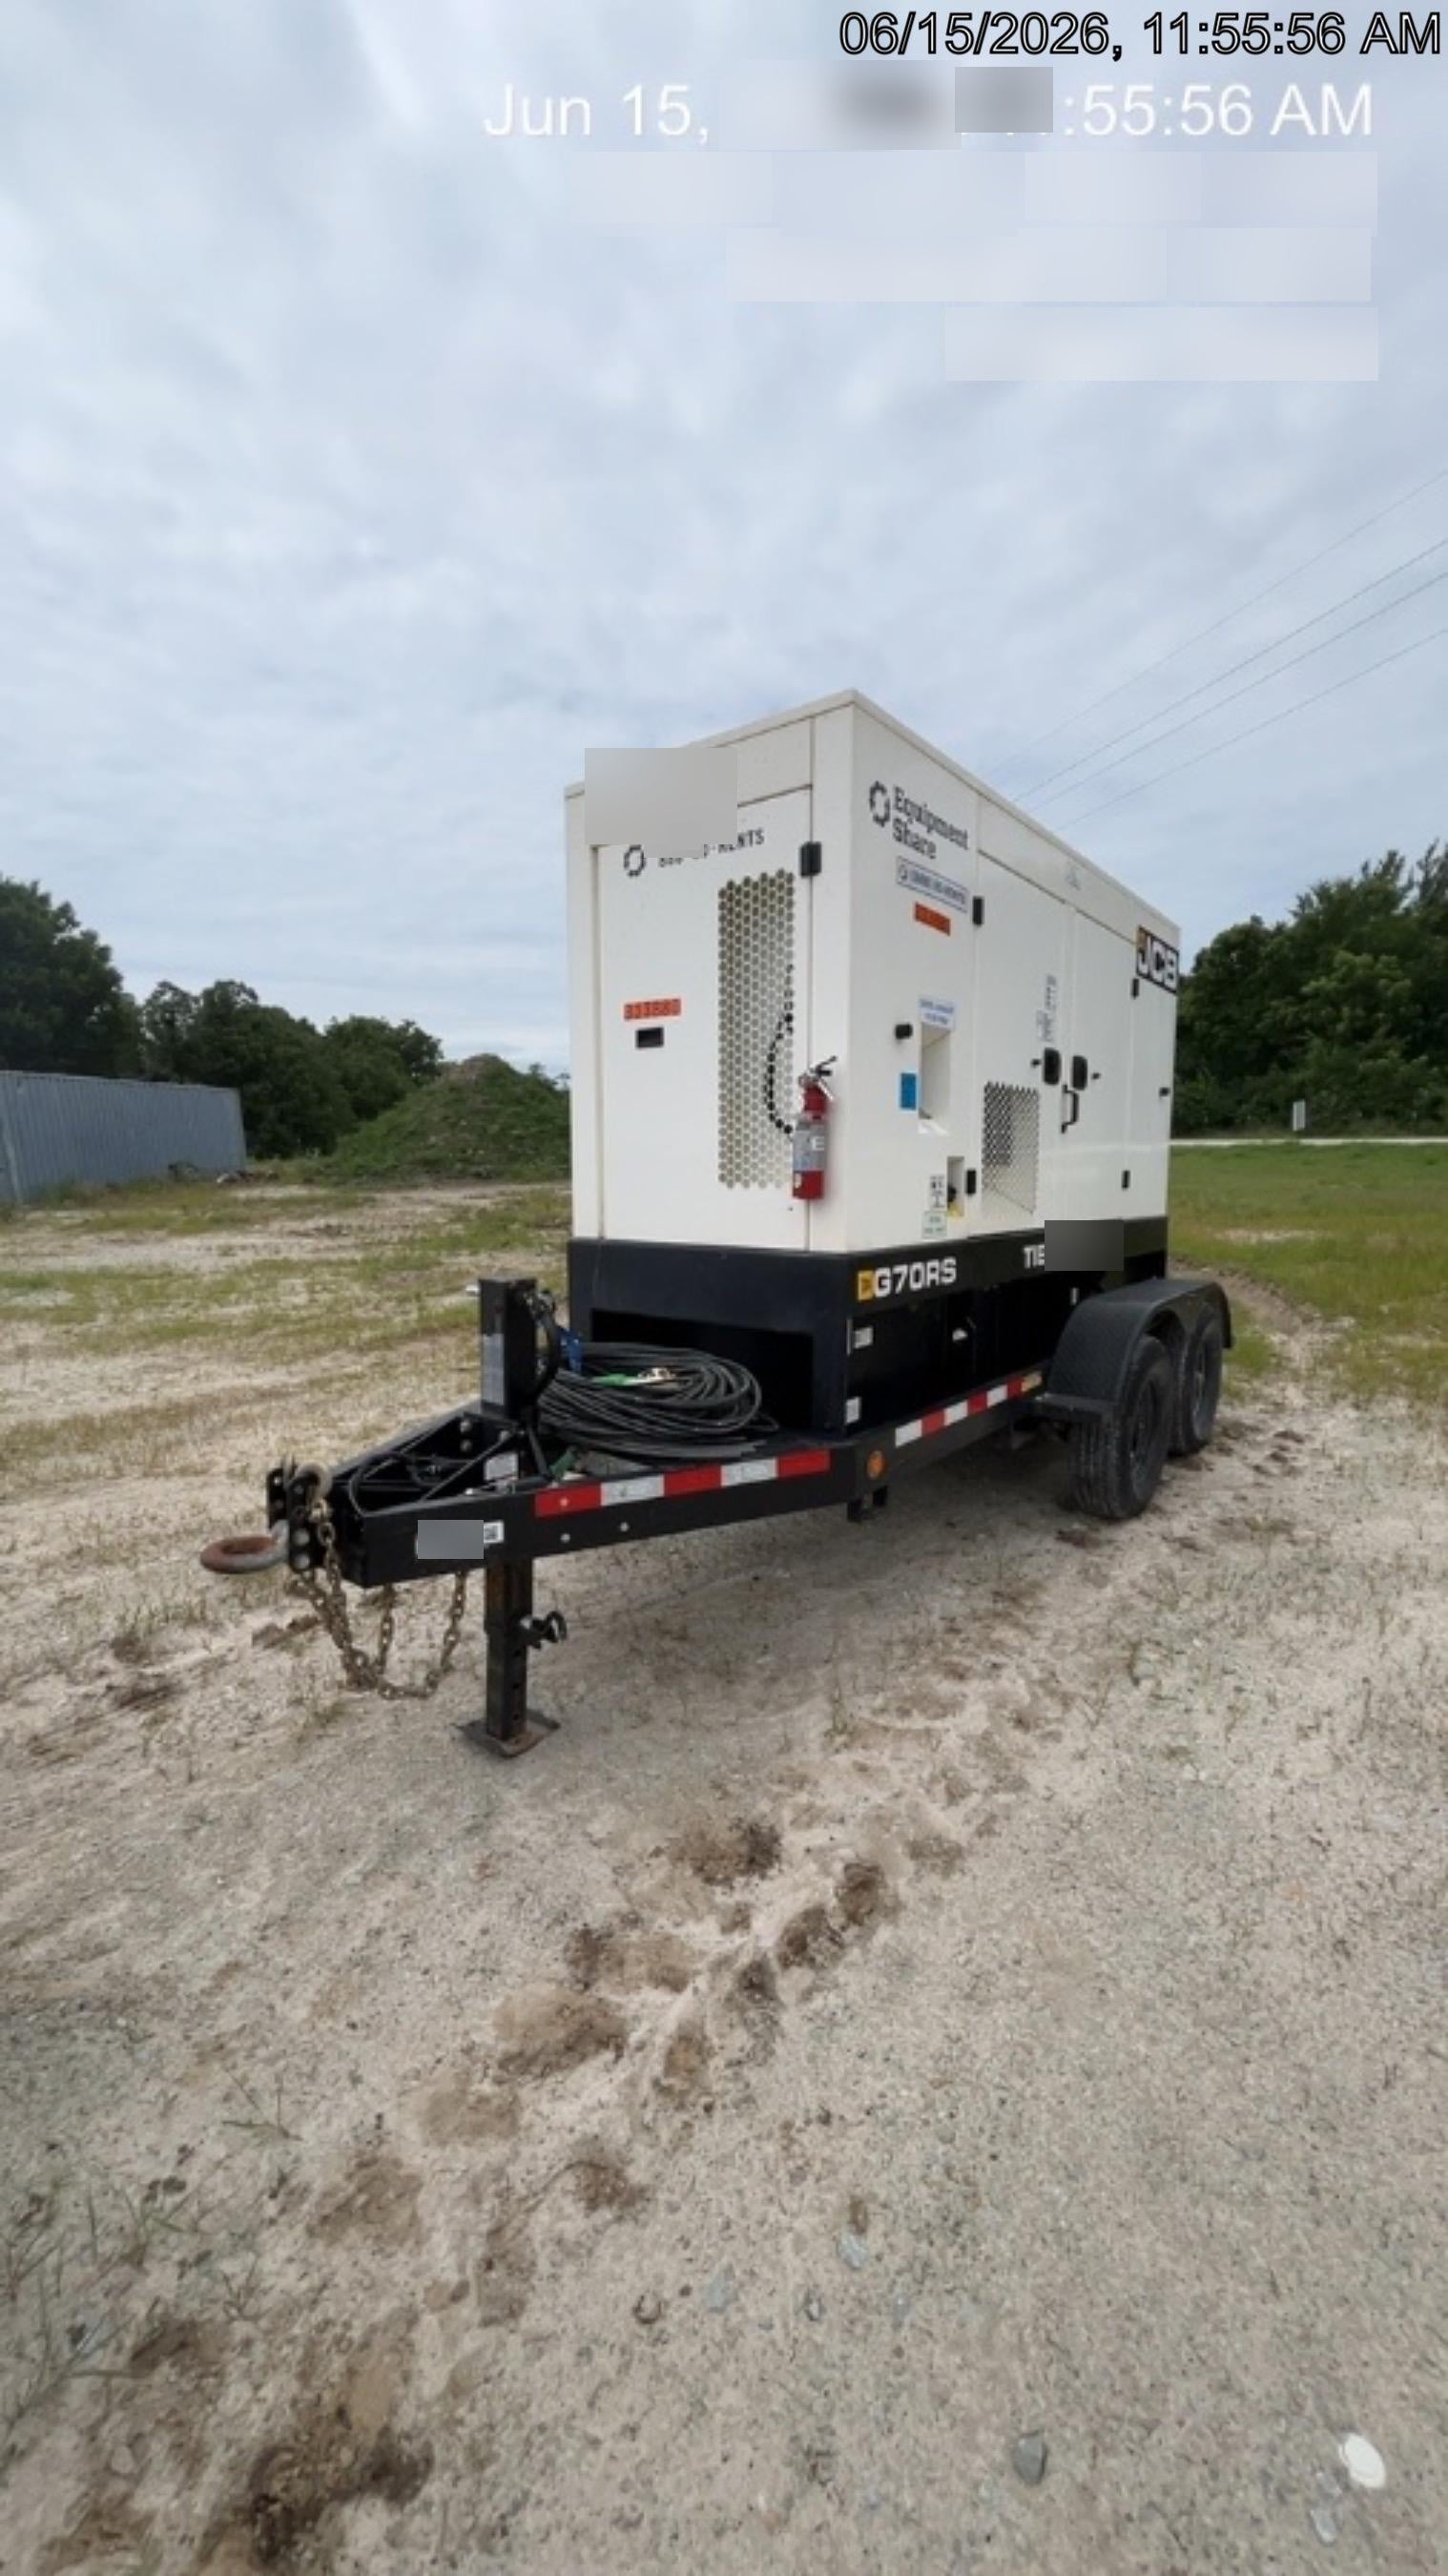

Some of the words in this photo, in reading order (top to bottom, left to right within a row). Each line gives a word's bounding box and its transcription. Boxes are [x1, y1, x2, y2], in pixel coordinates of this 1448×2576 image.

[893, 784, 968, 850] Equipment
[893, 818, 937, 859] Share
[1137, 930, 1178, 991] JCB
[1024, 1243, 1045, 1269] TIE
[875, 1257, 957, 1298] G70RS
